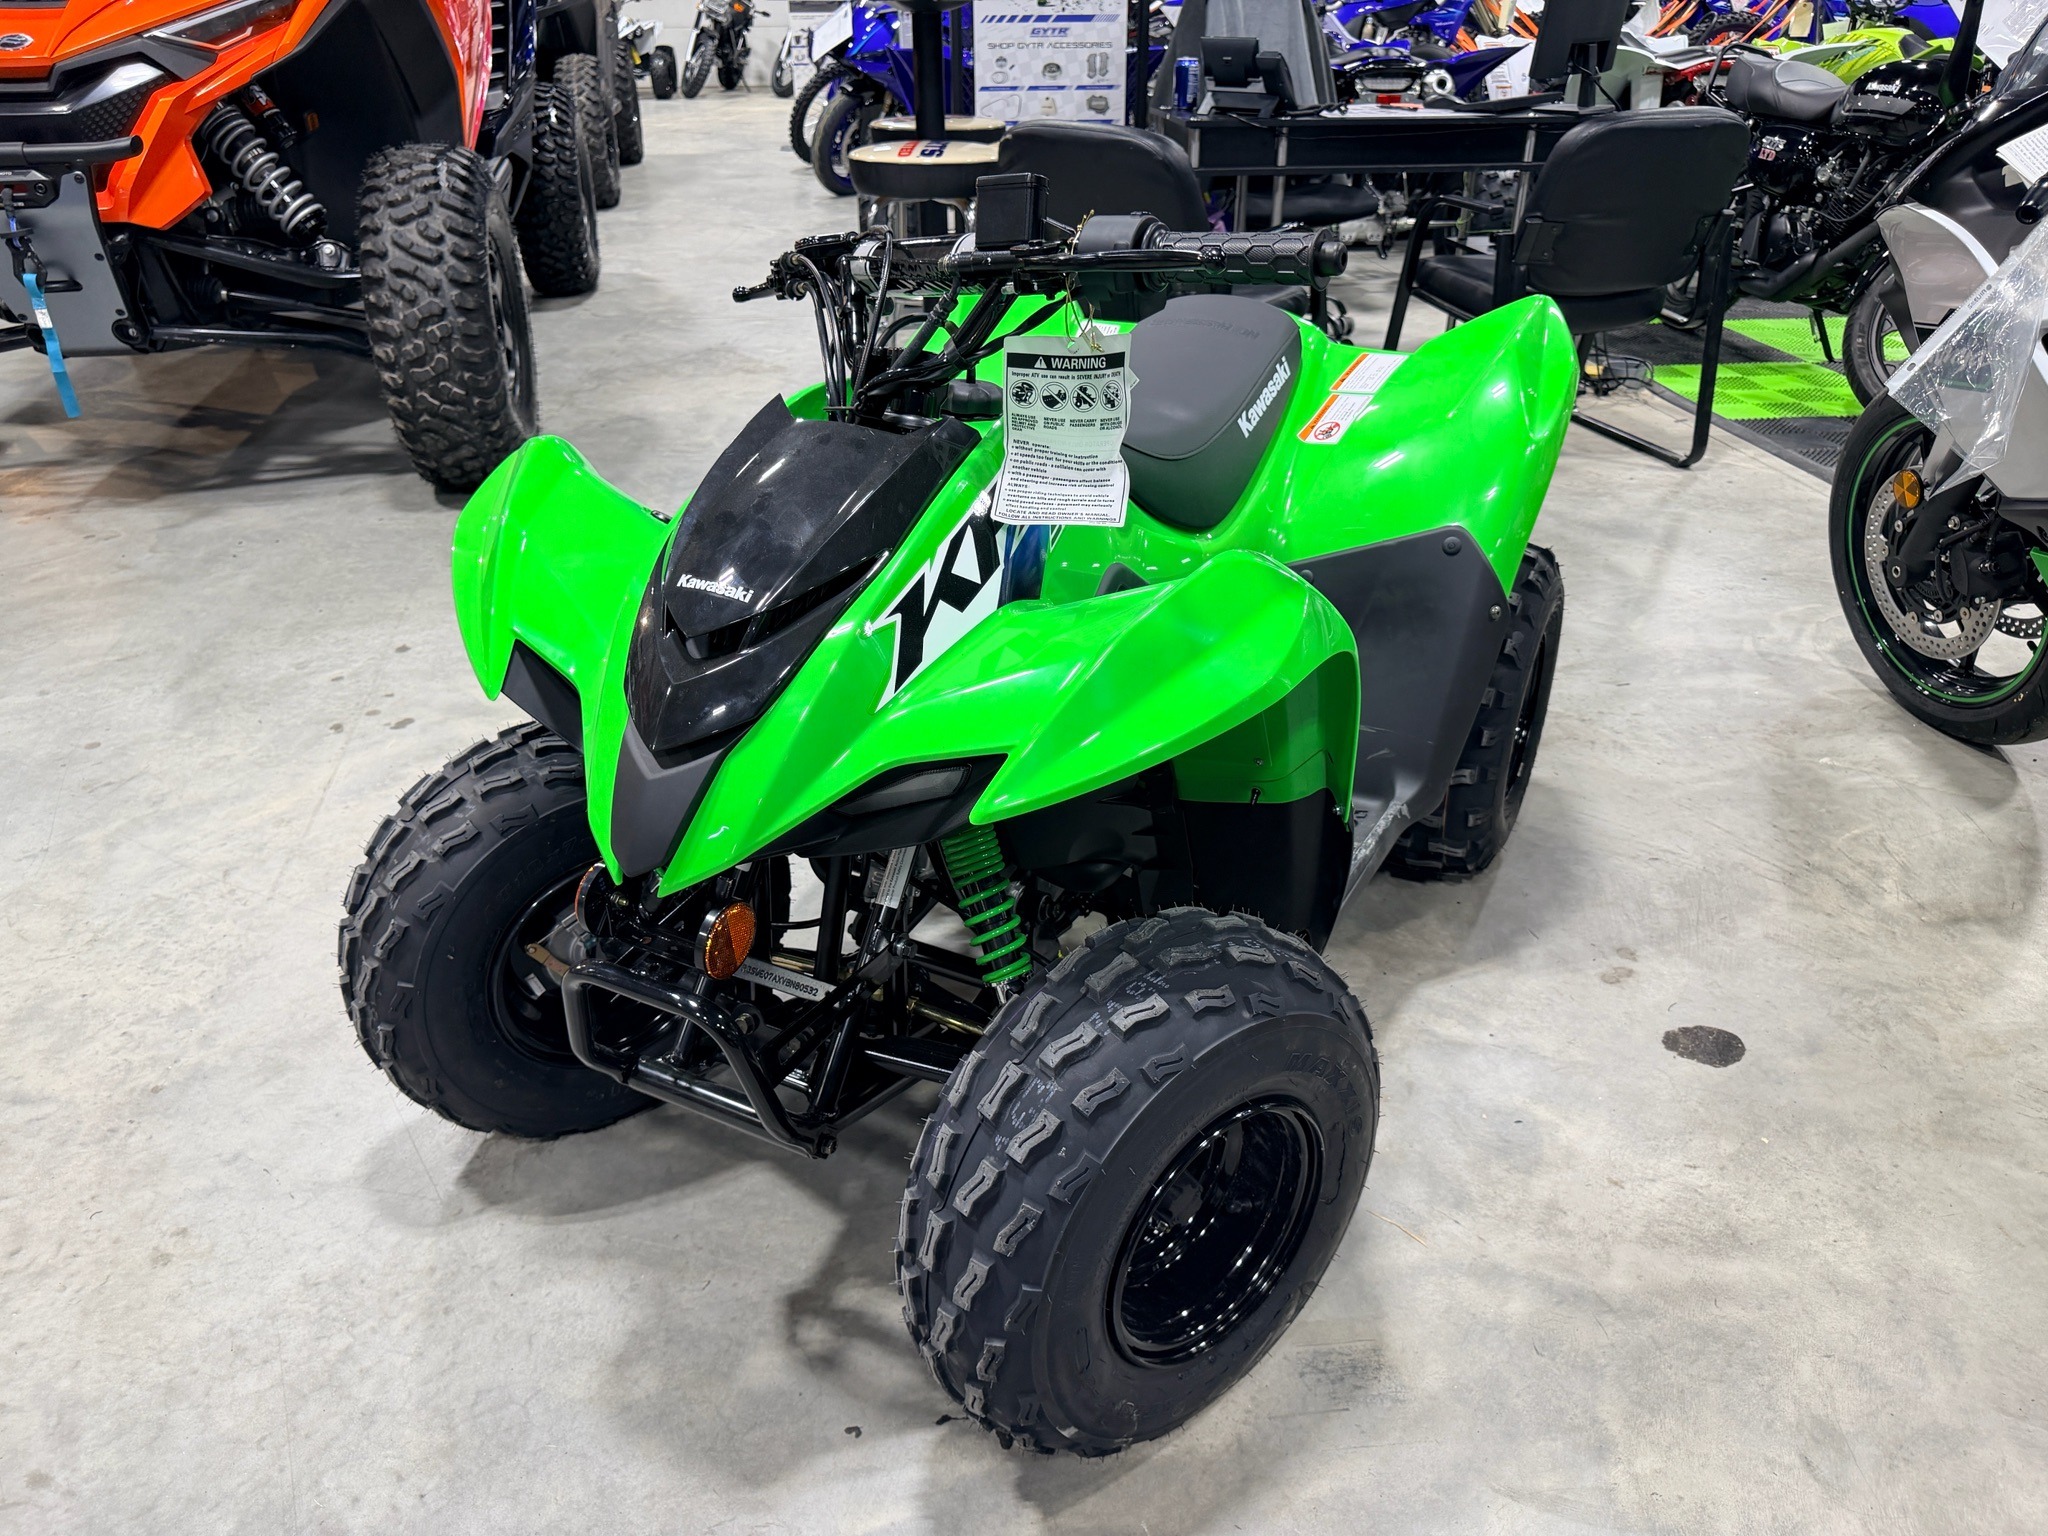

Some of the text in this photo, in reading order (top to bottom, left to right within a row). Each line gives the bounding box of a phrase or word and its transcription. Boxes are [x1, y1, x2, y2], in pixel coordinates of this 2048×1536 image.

[1030, 28, 1070, 36] GYTR
[1051, 357, 1106, 370] WARNING
[1236, 355, 1292, 439] Kawasaki
[676, 573, 755, 604] Kawasaki
